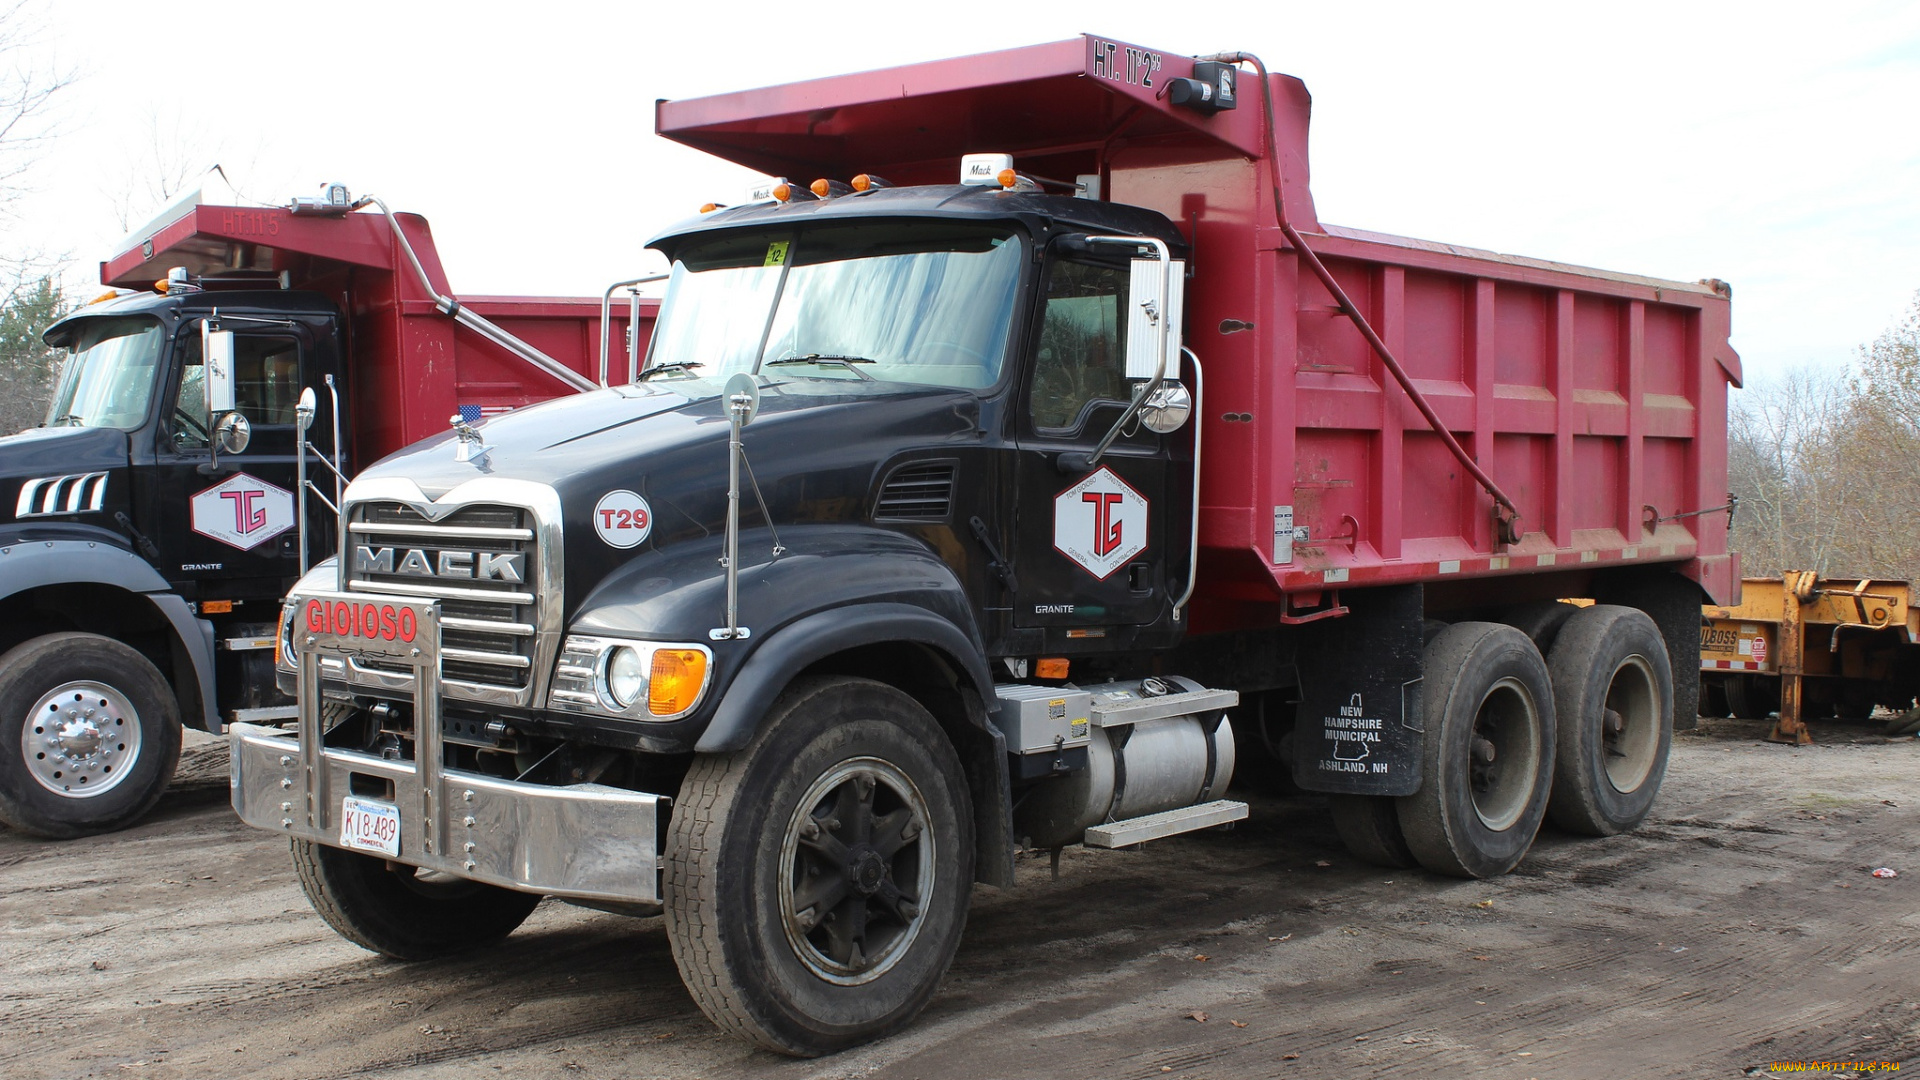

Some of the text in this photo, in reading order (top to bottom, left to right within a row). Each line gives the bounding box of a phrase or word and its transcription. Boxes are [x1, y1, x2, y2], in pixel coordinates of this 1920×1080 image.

[1094, 40, 1120, 81] HT.
[969, 164, 991, 176] Mack
[752, 189, 770, 201] Mack
[772, 250, 781, 262] 12
[1103, 471, 1136, 500] CONSTRUCTION
[600, 508, 649, 529] T29
[208, 528, 232, 541] GENERAL
[356, 545, 524, 583] MACK
[1068, 547, 1089, 566] GENERAL
[1109, 545, 1138, 570] CONTRACTOR
[306, 598, 417, 643] GIOIOSO
[1340, 706, 1362, 717] NEW
[1324, 716, 1382, 729] HAMPSHIRE
[1324, 729, 1381, 742] MUNICIPAL
[1318, 760, 1388, 774] ASHLAND, NH
